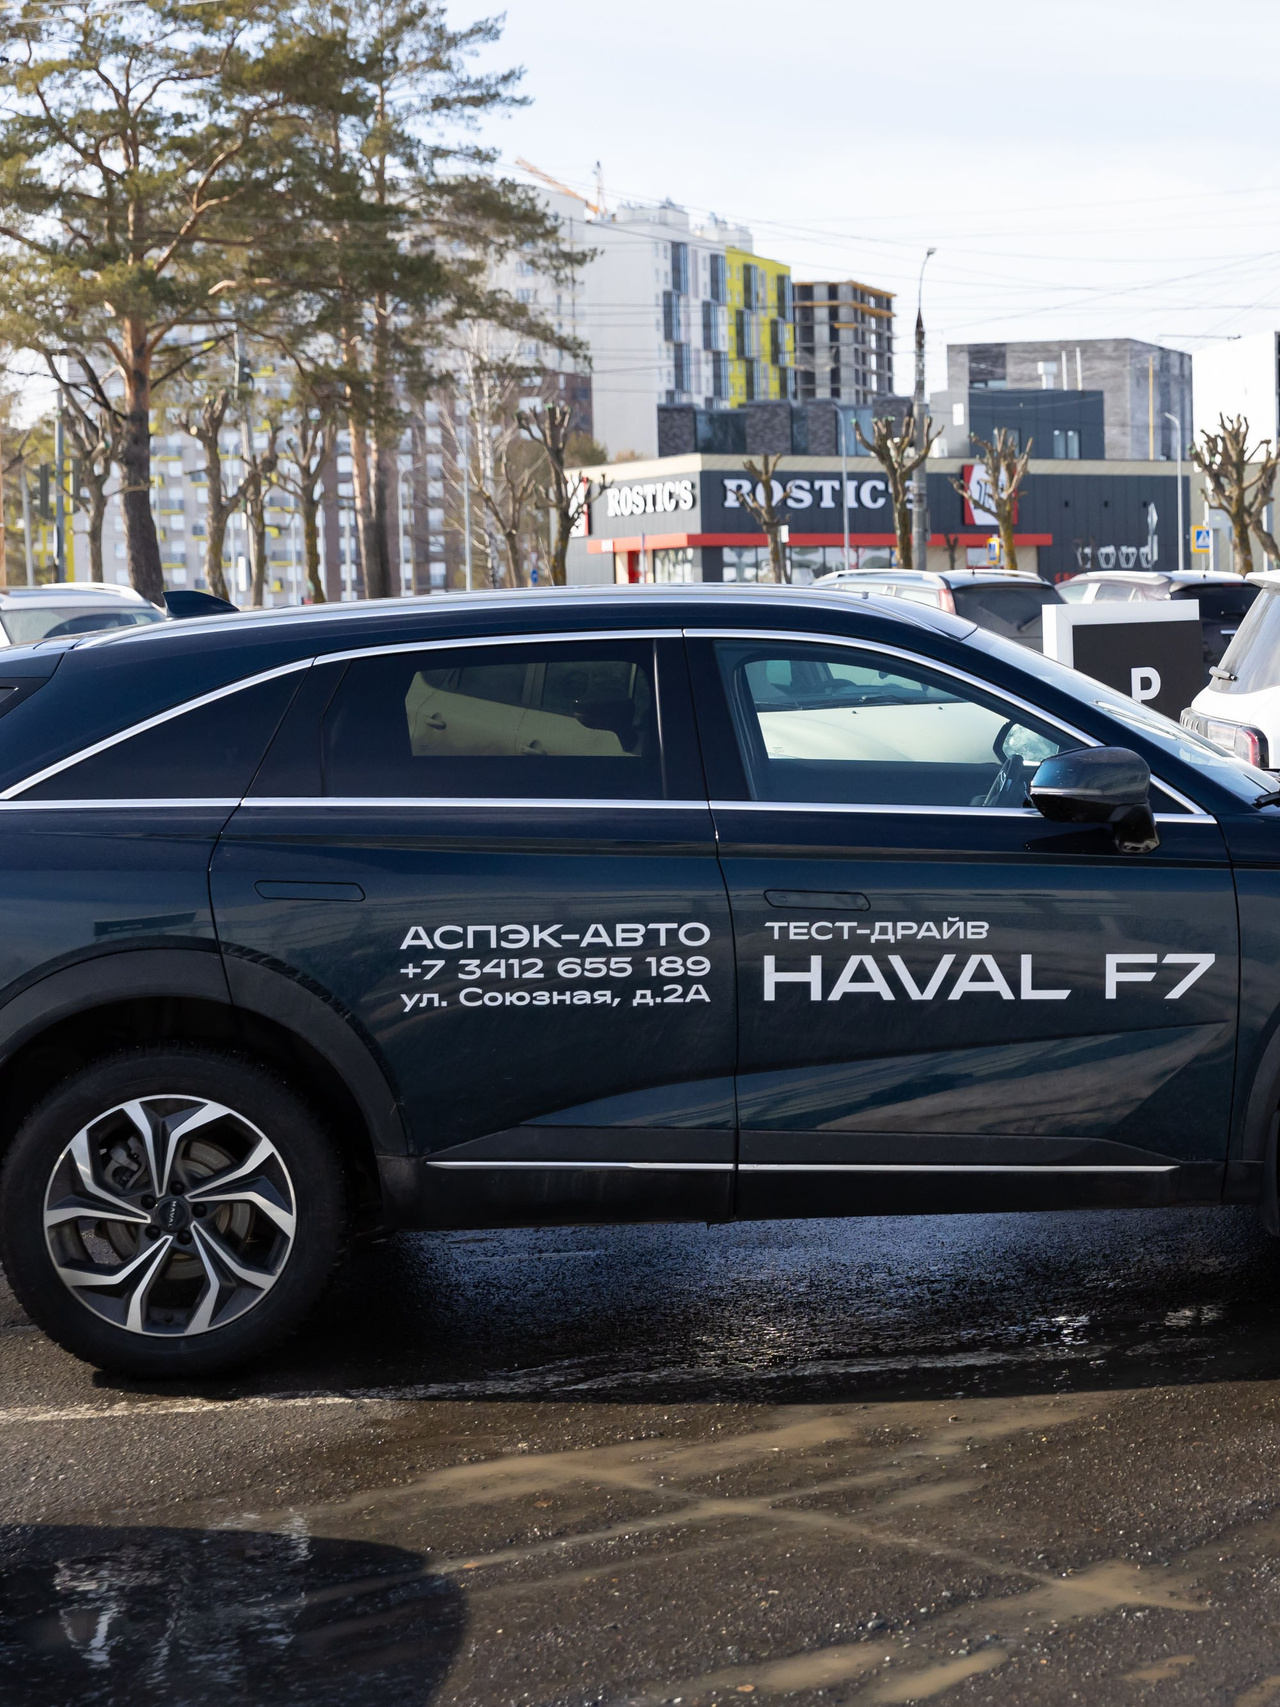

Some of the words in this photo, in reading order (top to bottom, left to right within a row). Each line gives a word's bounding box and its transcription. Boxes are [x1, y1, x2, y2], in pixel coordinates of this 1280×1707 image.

[606, 480, 694, 517] ROSTIC'S
[1131, 667, 1161, 703] P
[400, 922, 711, 949] АСПЭК-АВТО
[764, 917, 990, 943] ТЕСТ-ДРАЙВ
[400, 960, 446, 980] +7
[458, 958, 544, 979] 3412
[557, 957, 632, 978] 655
[645, 955, 711, 977] 189
[764, 954, 1072, 1001] HAVAL
[1105, 953, 1216, 999] F7
[400, 993, 447, 1012] ул.
[458, 987, 621, 1007] Союзная,
[632, 984, 711, 1006] д.2А
